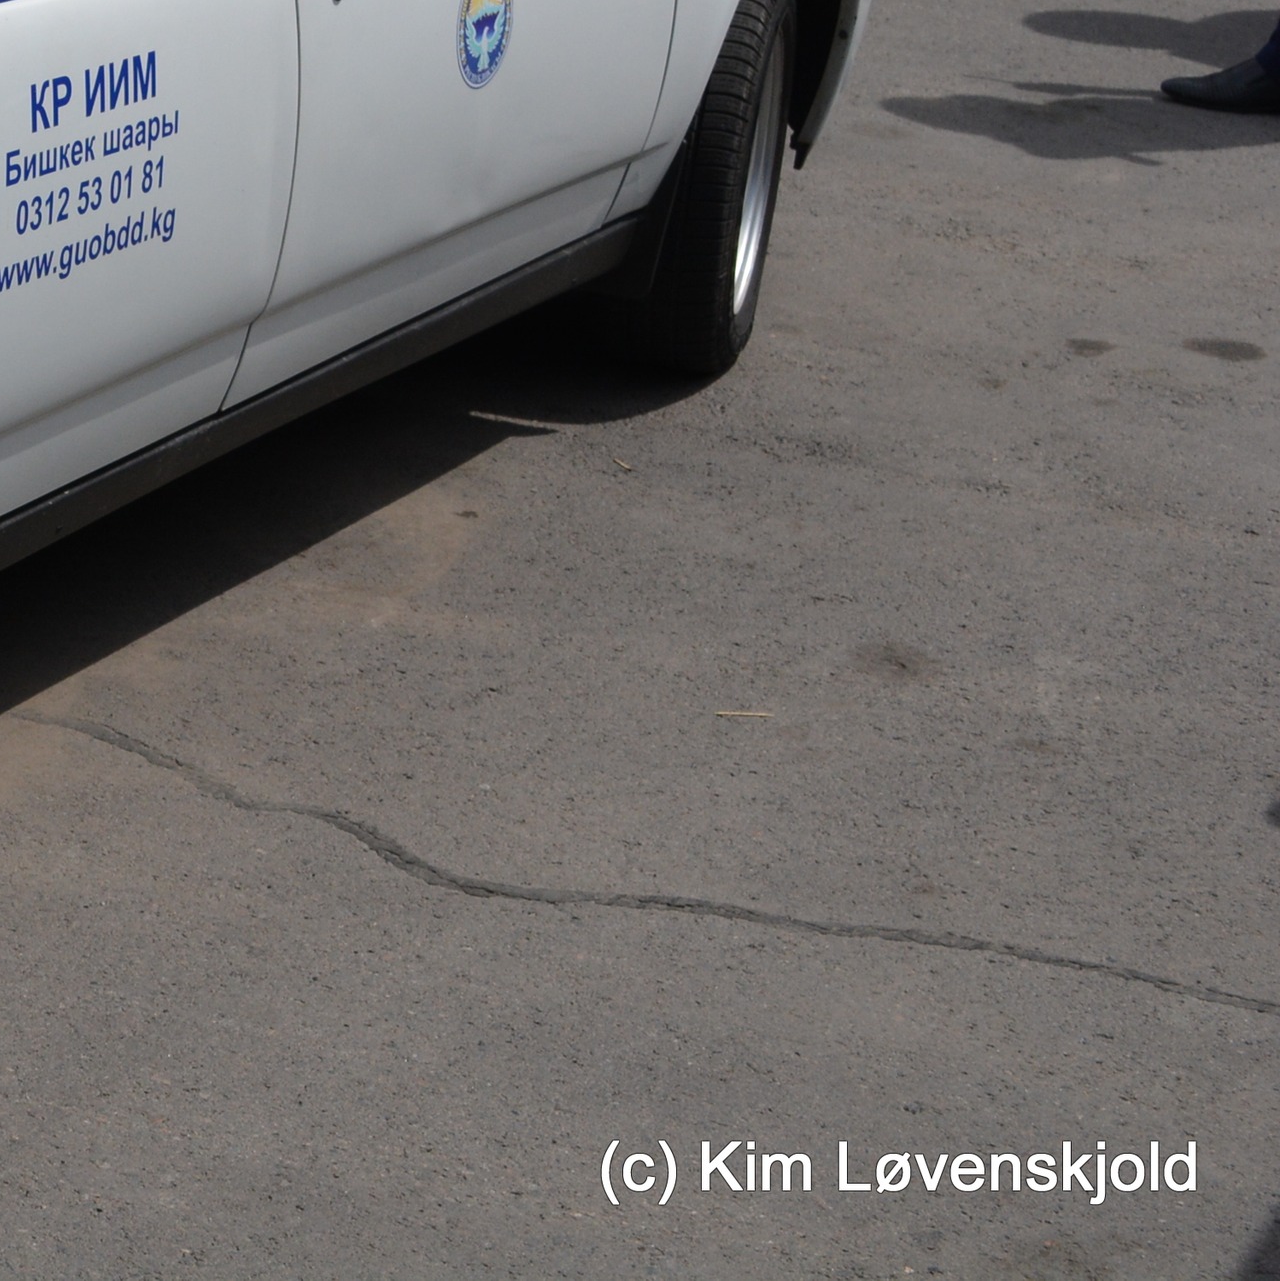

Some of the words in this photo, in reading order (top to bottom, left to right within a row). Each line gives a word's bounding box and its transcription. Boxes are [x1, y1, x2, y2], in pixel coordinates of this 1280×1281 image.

[30, 75, 73, 133] КР
[84, 50, 157, 118] ИИМ
[5, 135, 96, 187] Бишкек
[103, 110, 179, 151] шаары
[16, 186, 70, 236] 0312
[77, 176, 103, 215] 53
[109, 165, 133, 204] 01
[141, 155, 165, 193] 81
